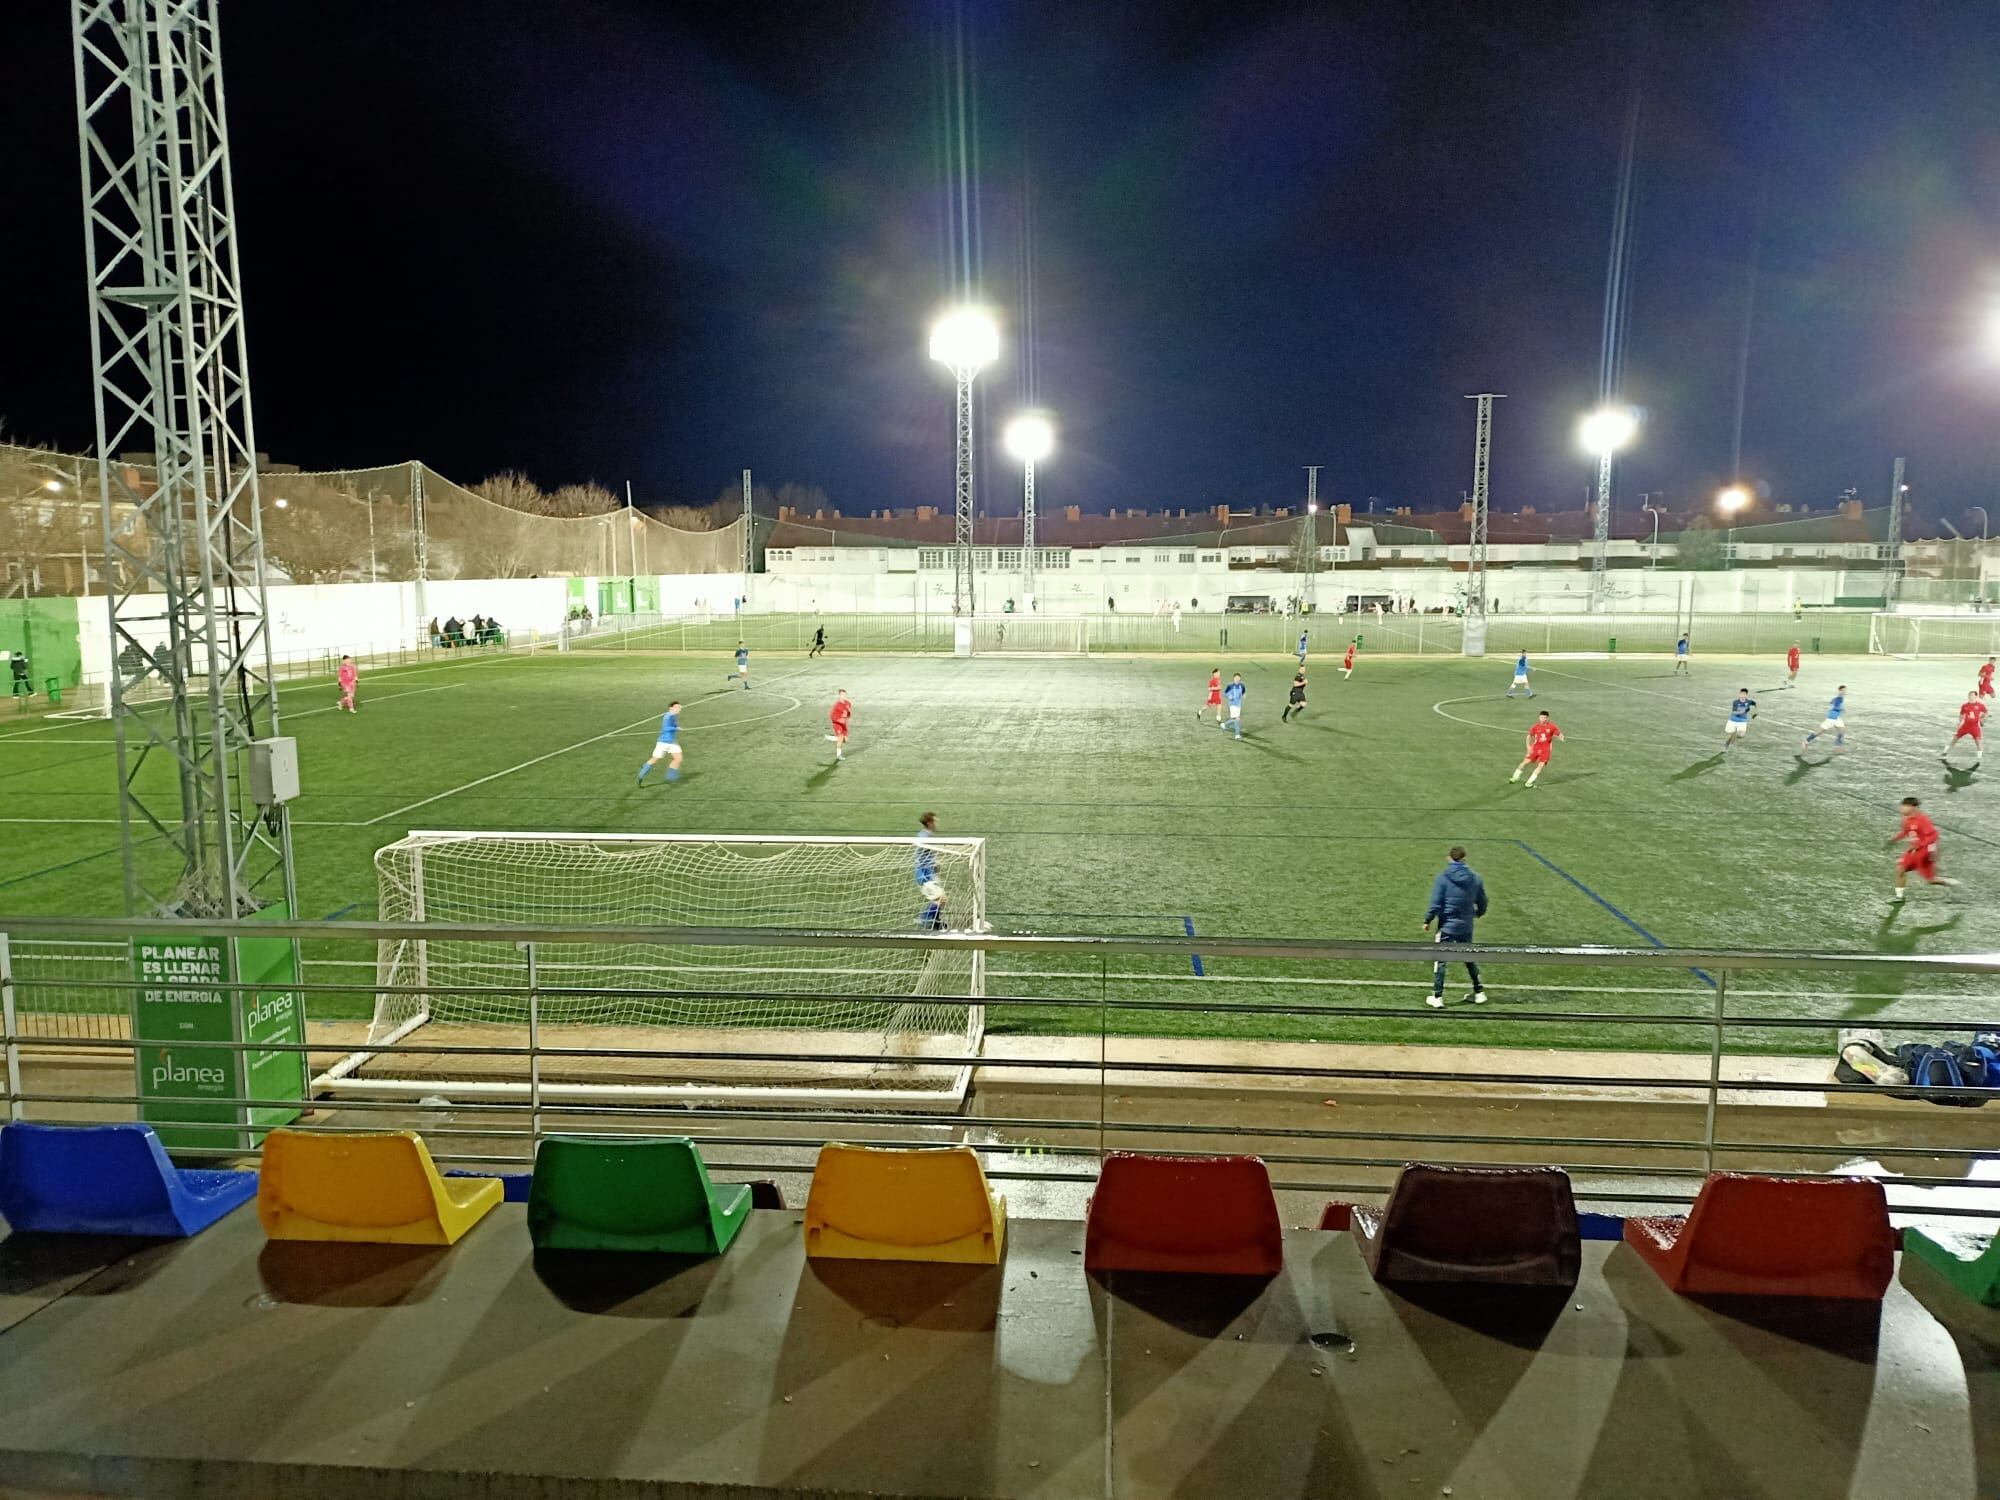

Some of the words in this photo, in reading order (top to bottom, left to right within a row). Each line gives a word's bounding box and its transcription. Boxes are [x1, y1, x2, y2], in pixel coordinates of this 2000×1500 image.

[142, 946, 220, 960] PLANEAR
[143, 962, 162, 974] ES
[164, 962, 220, 974] LLENAR
[145, 991, 163, 1002] DE
[248, 992, 293, 1038] planea
[152, 1054, 224, 1090] planea
